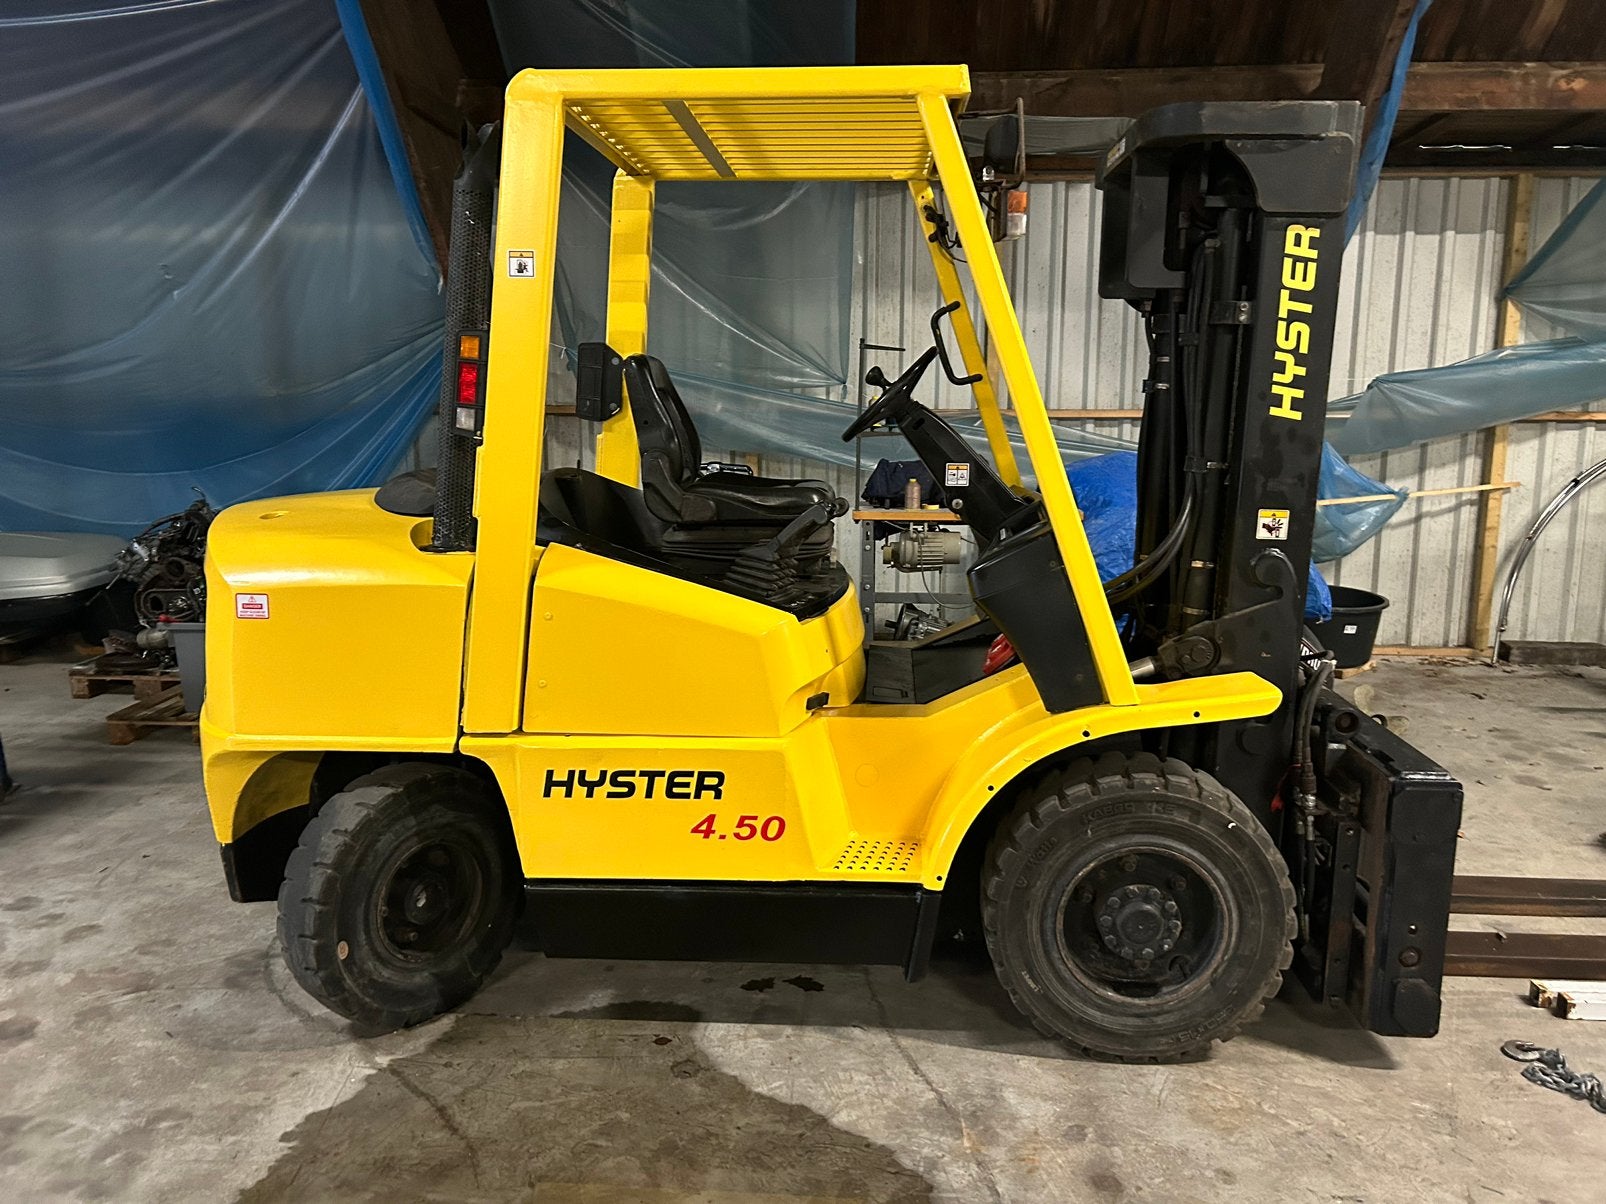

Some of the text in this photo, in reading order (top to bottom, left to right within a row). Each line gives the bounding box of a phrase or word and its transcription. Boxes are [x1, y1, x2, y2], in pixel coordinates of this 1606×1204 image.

[1269, 224, 1320, 421] HYSTER
[543, 769, 726, 800] HYSTER
[690, 813, 786, 842] 4.50
